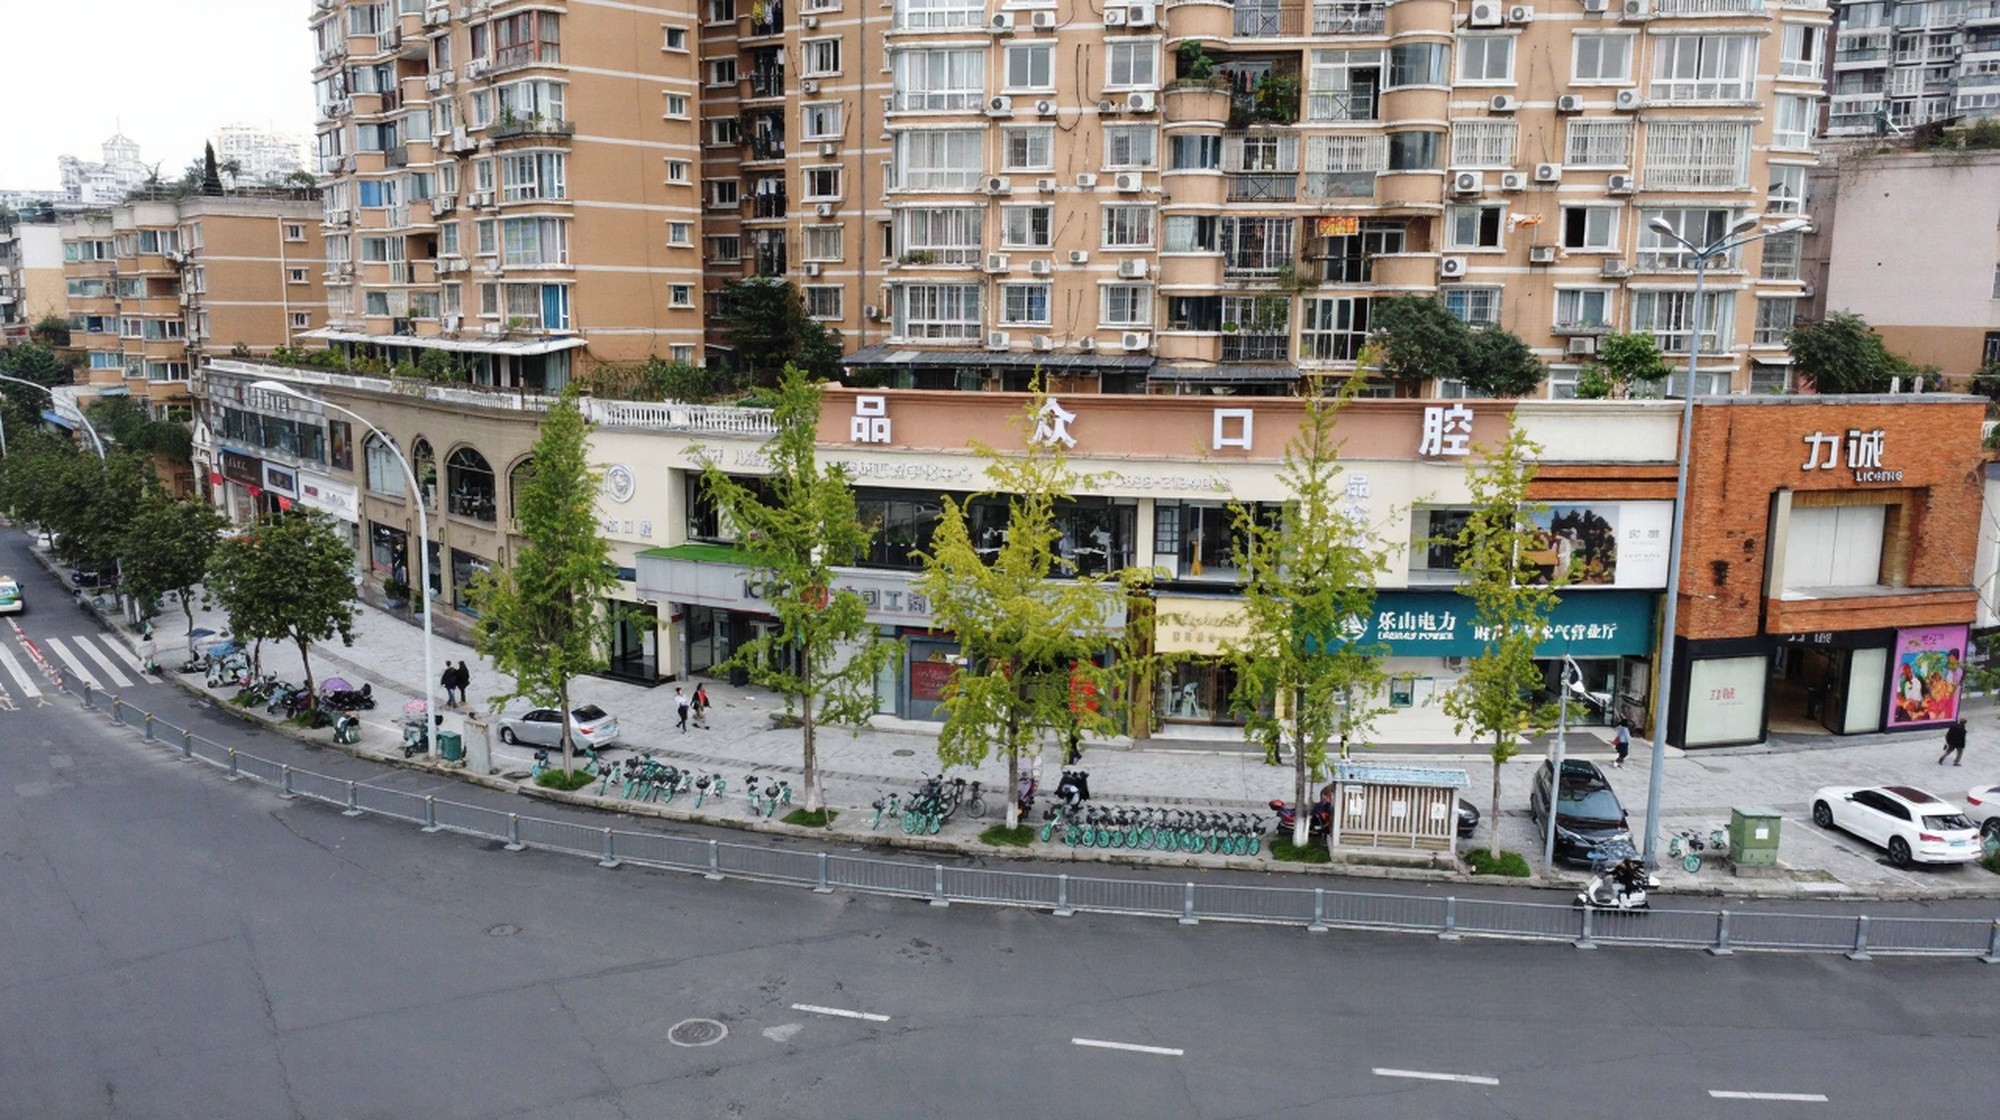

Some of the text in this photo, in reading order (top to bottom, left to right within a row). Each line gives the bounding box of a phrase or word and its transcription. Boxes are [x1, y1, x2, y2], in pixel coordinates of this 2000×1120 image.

[850, 395, 1475, 458] 品众口腔
[1802, 430, 1885, 470] 力诚
[1377, 611, 1457, 631] 乐山电力
